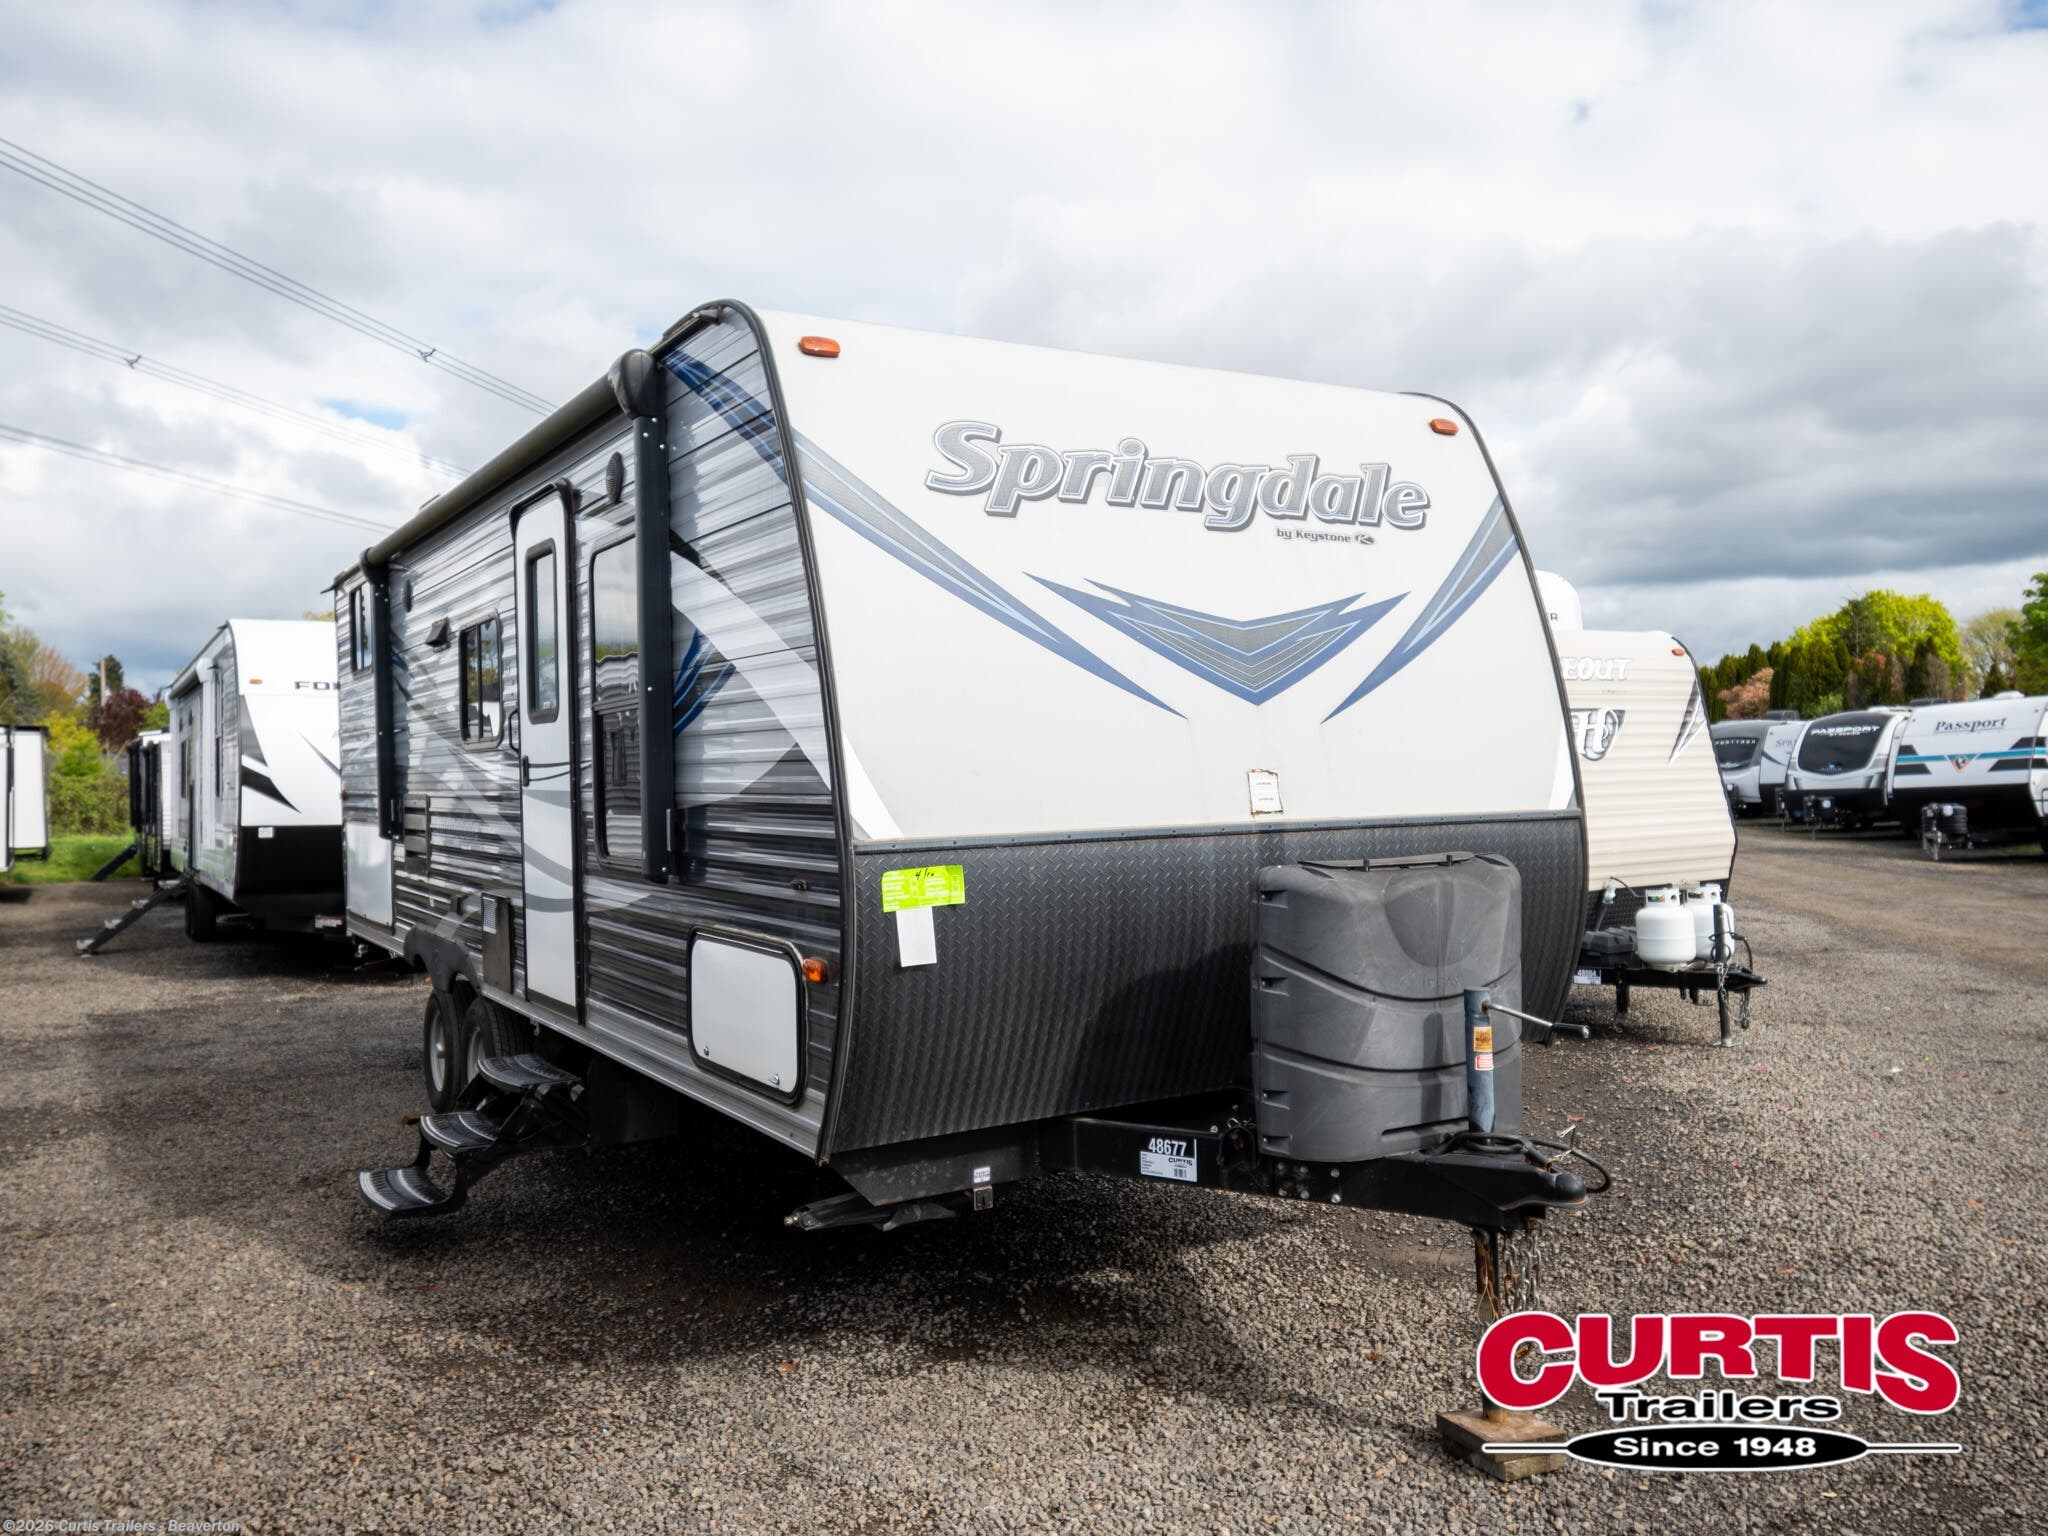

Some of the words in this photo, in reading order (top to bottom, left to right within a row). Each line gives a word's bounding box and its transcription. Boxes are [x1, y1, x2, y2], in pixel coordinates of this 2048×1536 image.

[926, 420, 1430, 531] Springdale
[1276, 528, 1292, 540] by
[1296, 529, 1352, 543] Keystone
[1811, 726, 1880, 735] PASSPORT
[1935, 717, 2007, 732] Passport
[1148, 1138, 1187, 1157] 48677
[1168, 1157, 1193, 1166] CURTIS
